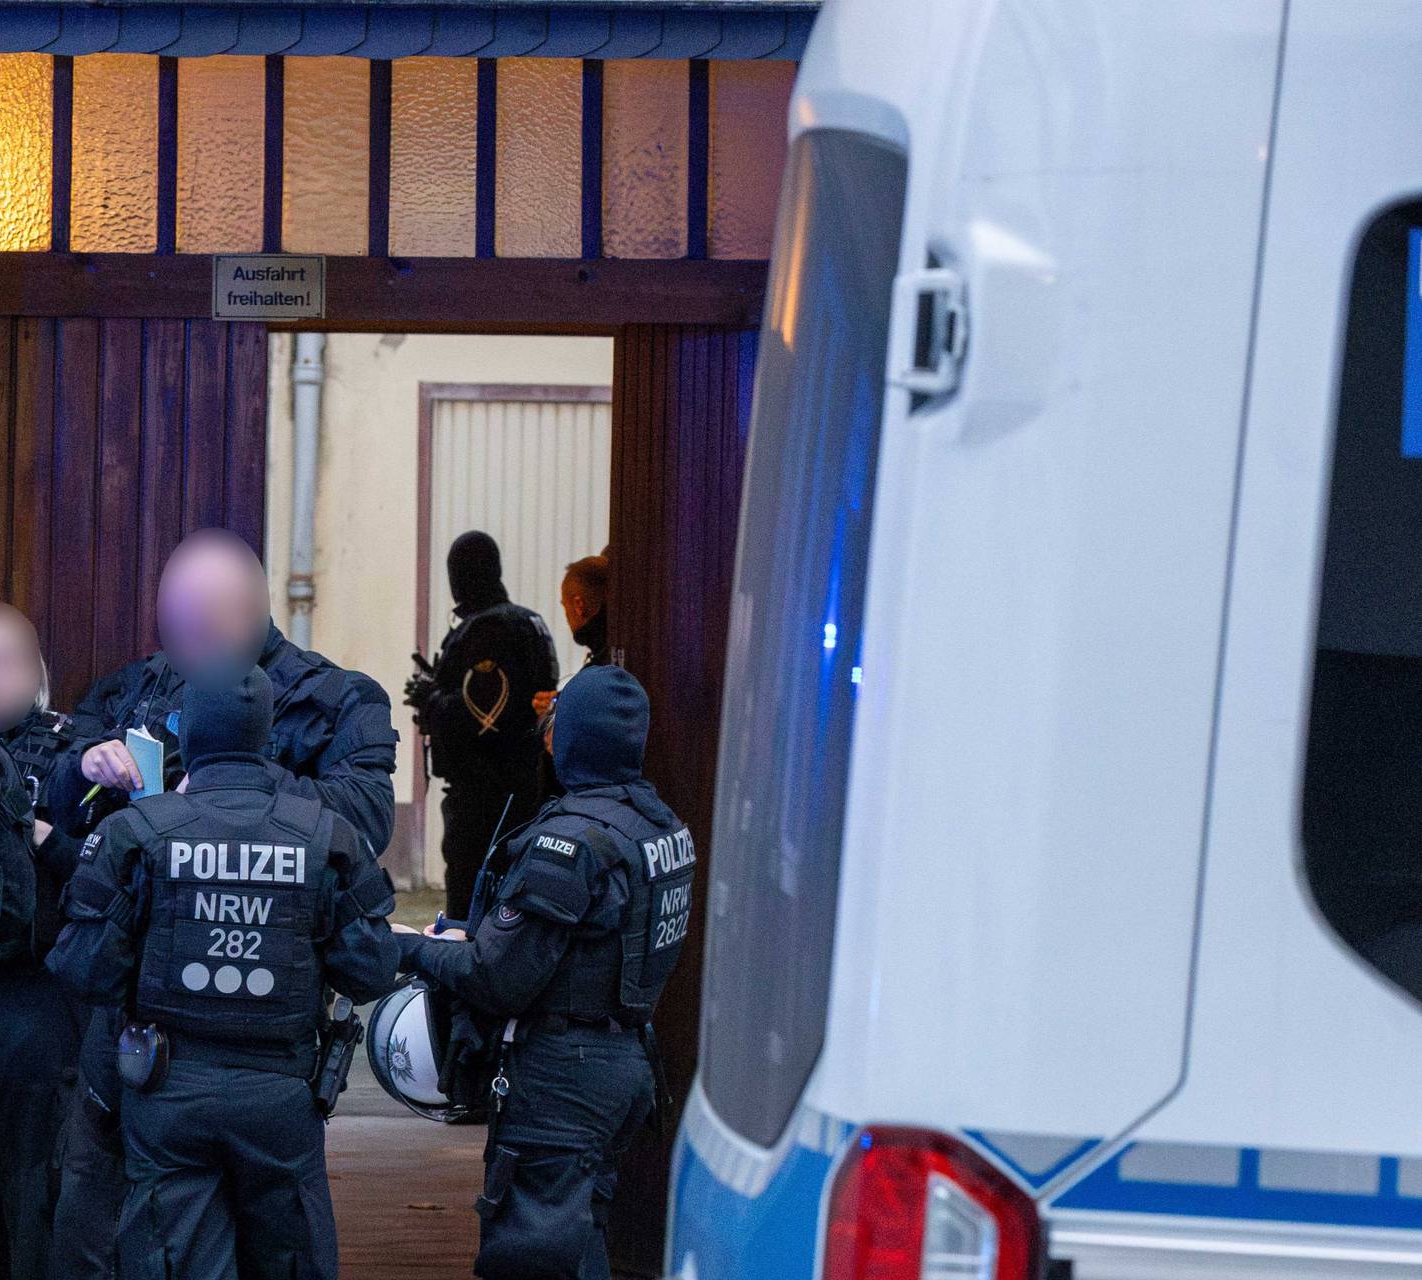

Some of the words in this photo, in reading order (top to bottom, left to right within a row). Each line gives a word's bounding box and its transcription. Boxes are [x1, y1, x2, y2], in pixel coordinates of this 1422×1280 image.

[233, 266, 306, 281] Ausfahrt
[227, 291, 311, 306] freihalten!
[536, 835, 576, 856] POLIZEI
[170, 841, 305, 884] POLIZEI
[194, 892, 273, 925] NRW
[207, 928, 262, 960] 282
[655, 910, 690, 949] 2822
